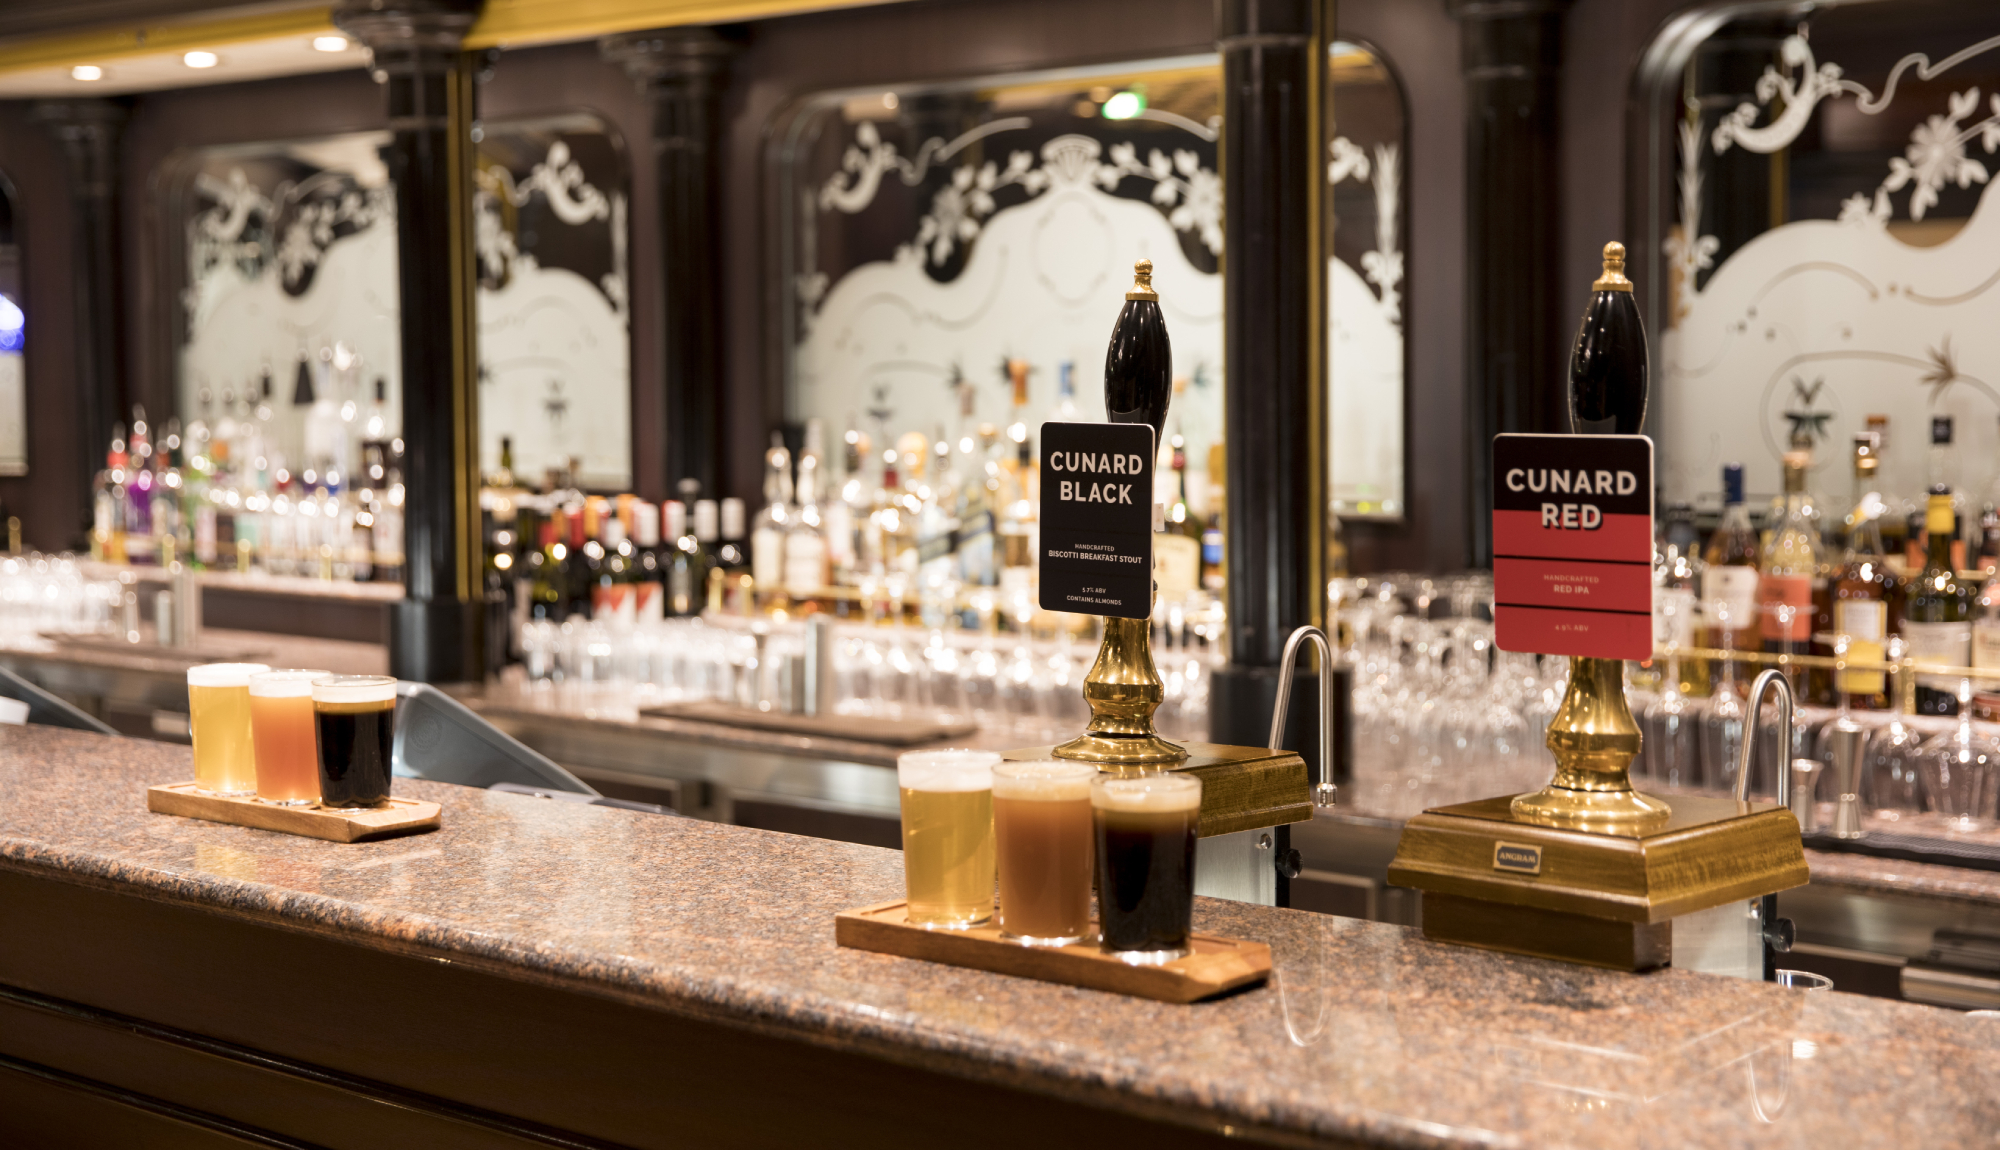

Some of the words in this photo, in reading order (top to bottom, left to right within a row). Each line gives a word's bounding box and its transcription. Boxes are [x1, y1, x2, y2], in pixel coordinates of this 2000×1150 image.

[1050, 452, 1142, 475] CUNARD
[1506, 468, 1637, 495] CUNARD
[1060, 481, 1132, 505] BLACK
[1541, 503, 1603, 530] RED
[1074, 544, 1114, 552] HANDCRAFTED
[1048, 550, 1078, 558] BISCOTTI
[1080, 552, 1118, 562] BREAKFAST
[1120, 556, 1142, 564] STOUT
[1544, 574, 1599, 584] HANDCRAFTED
[1554, 584, 1572, 593] RED
[1574, 586, 1589, 594] IPA
[1066, 595, 1094, 603] CONTAINS
[1500, 852, 1536, 863] ANGRAM
